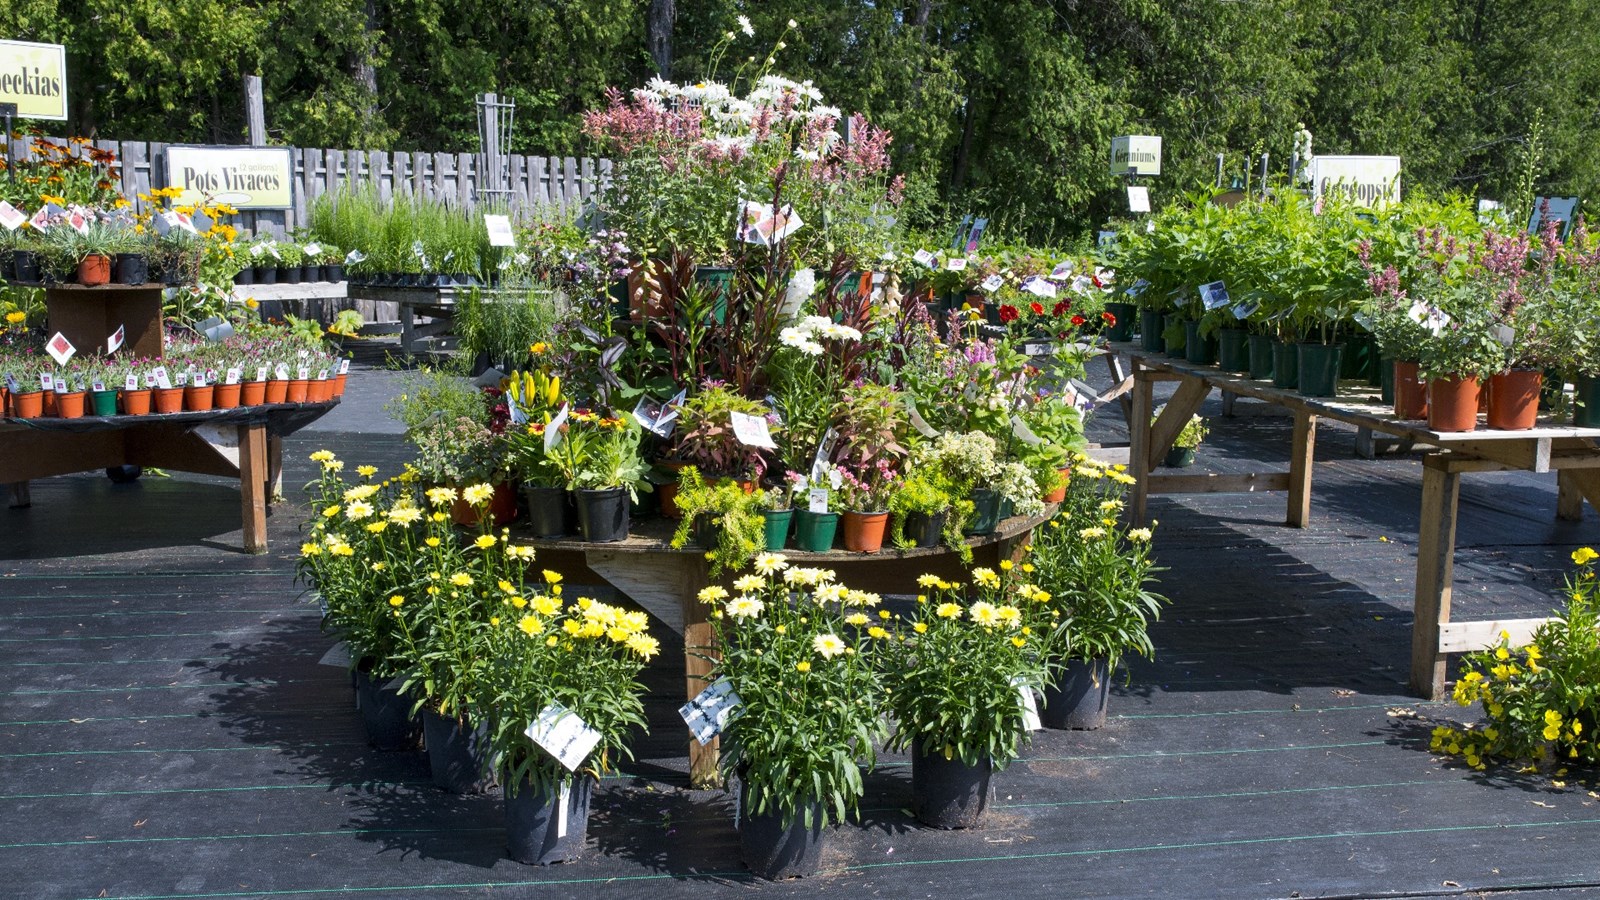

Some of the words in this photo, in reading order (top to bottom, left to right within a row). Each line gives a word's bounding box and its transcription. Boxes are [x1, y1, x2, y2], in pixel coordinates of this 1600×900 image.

[0, 66, 60, 97] eckias
[1115, 148, 1156, 163] Géraniums
[183, 166, 219, 191] Pots
[222, 166, 280, 191] Vivaces
